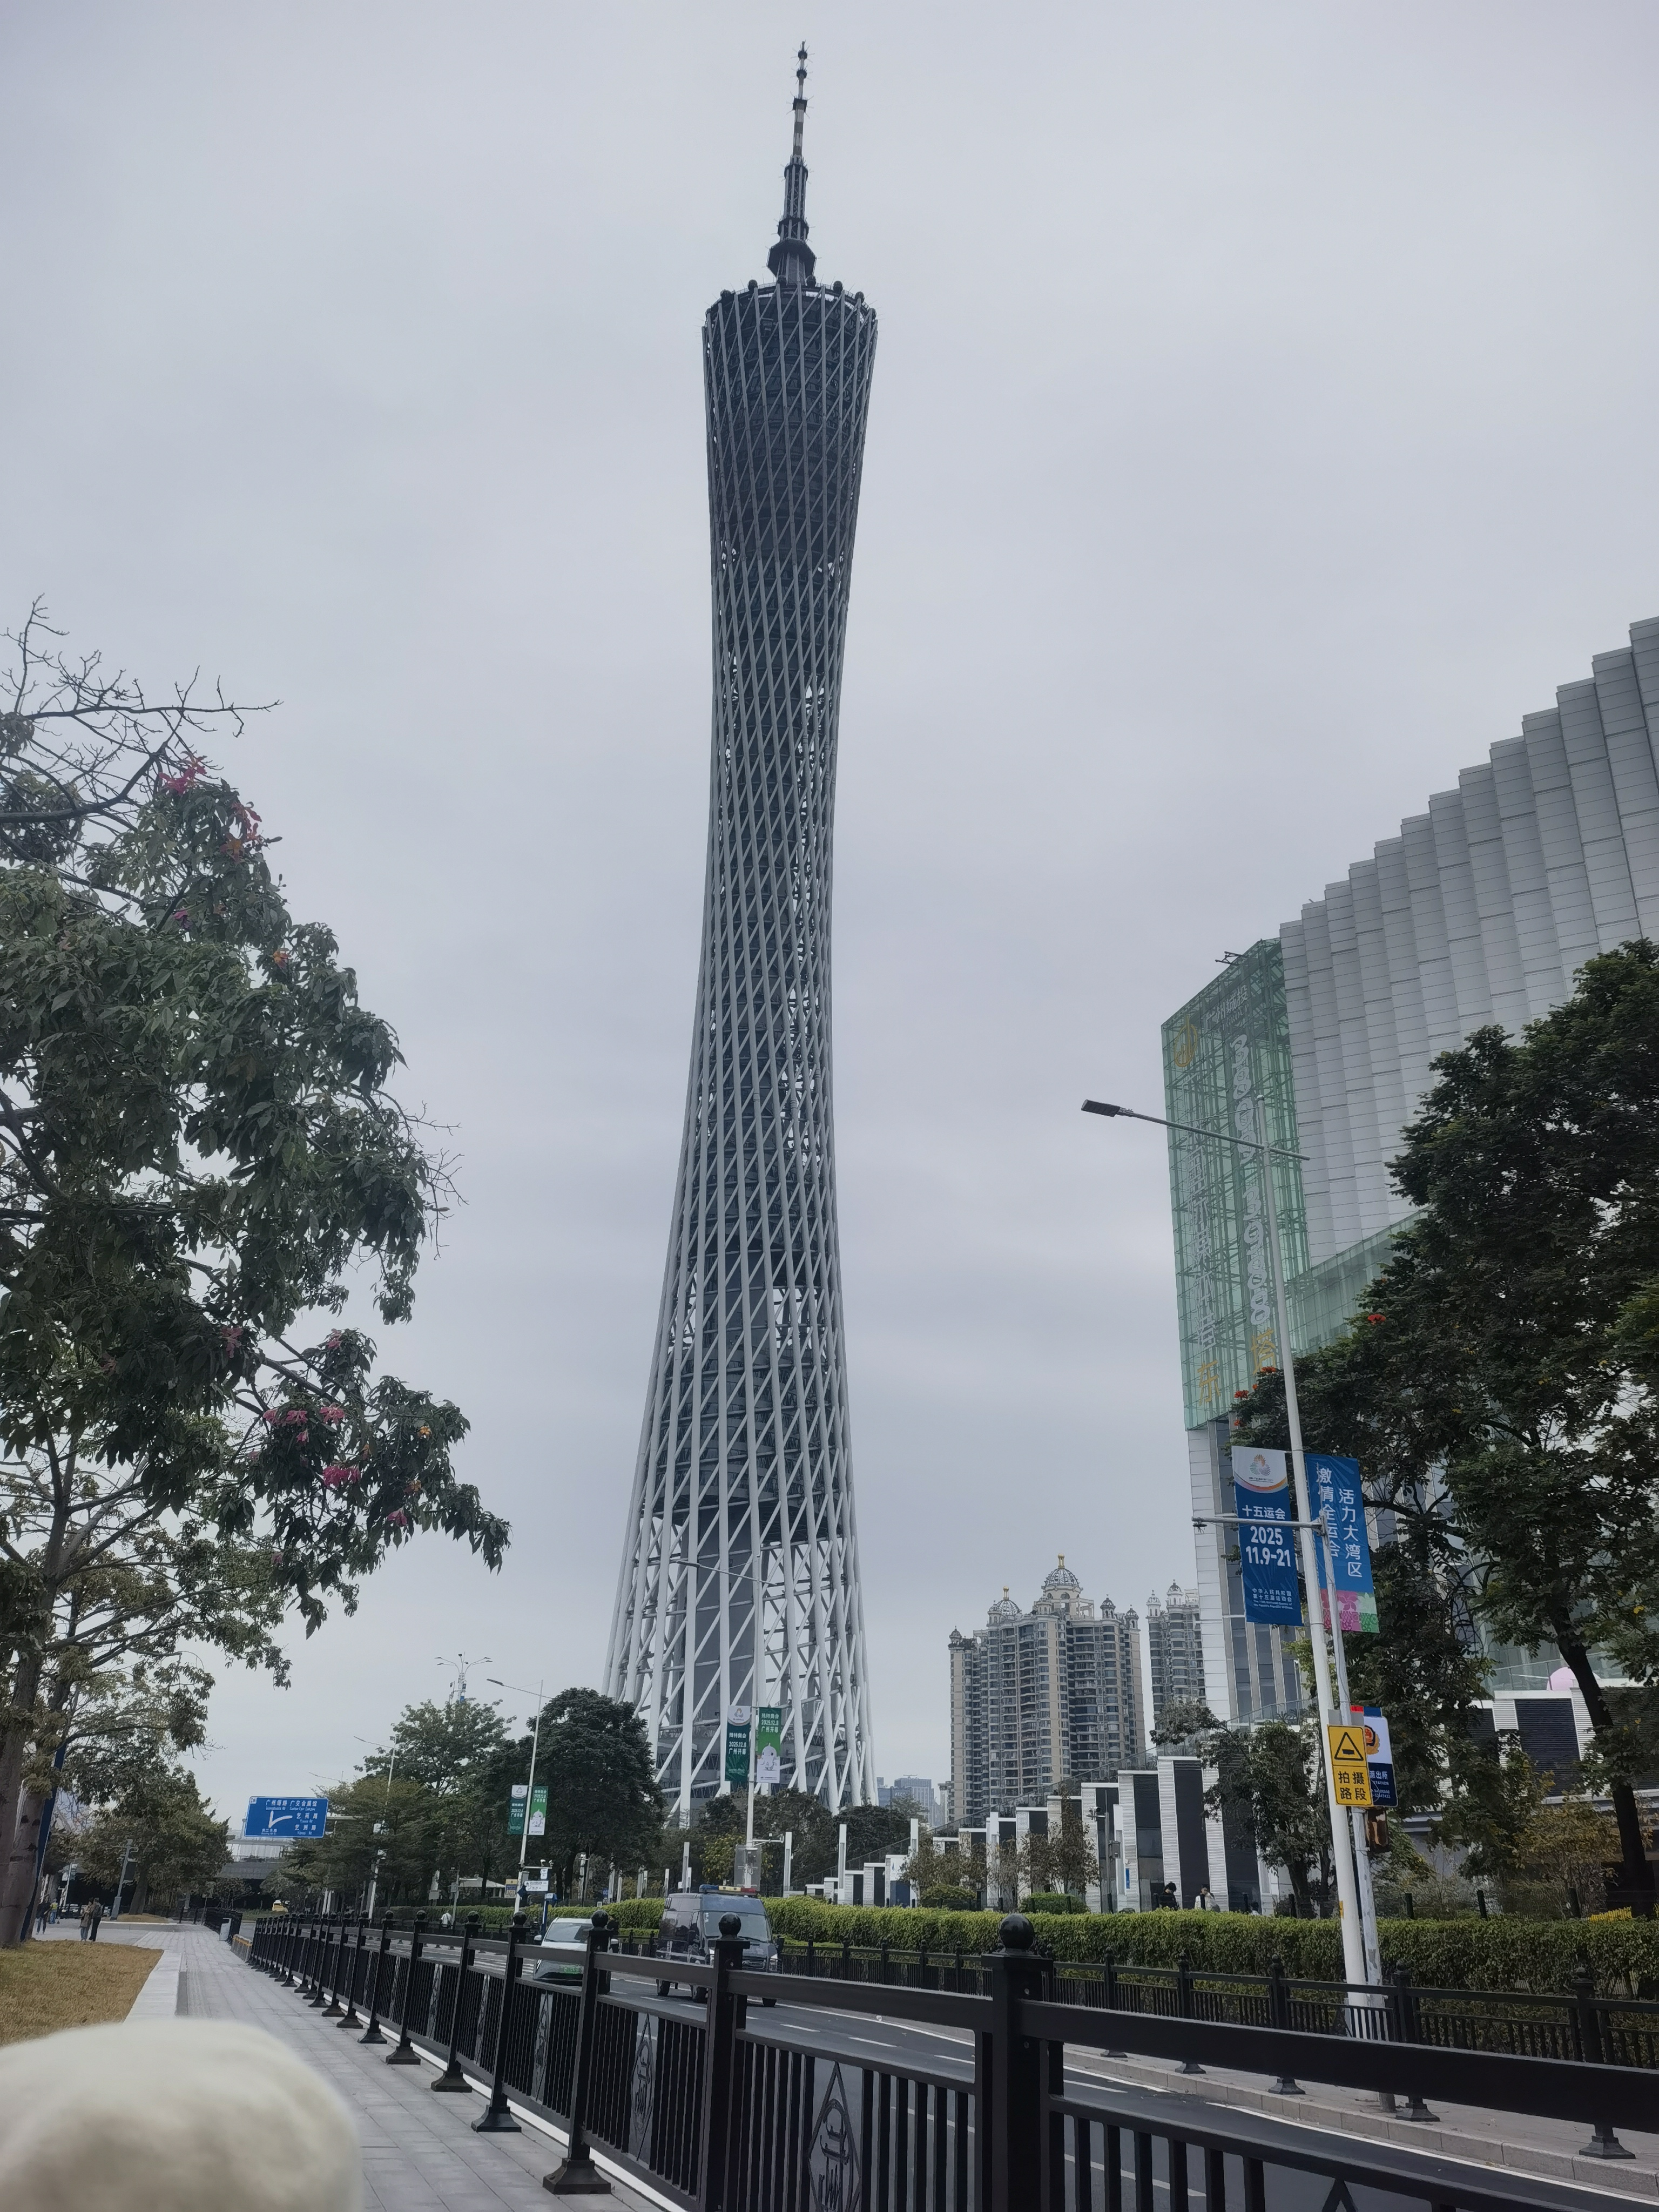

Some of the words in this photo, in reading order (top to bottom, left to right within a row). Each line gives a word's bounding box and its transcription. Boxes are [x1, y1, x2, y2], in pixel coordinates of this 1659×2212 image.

[1205, 984, 1248, 1033] 广州城投
[1242, 1505, 1285, 1520] 十五运会
[1250, 1526, 1283, 1546] 2025
[1339, 1488, 1363, 1577] 活力大湾区
[1246, 1546, 1291, 1567] 11.9-21
[1252, 1588, 1292, 1596] 中华人民共和国
[1253, 1594, 1292, 1602] 第十五届运动会
[1338, 1771, 1365, 1785] 拍摄
[1340, 1787, 1367, 1801] 路段
